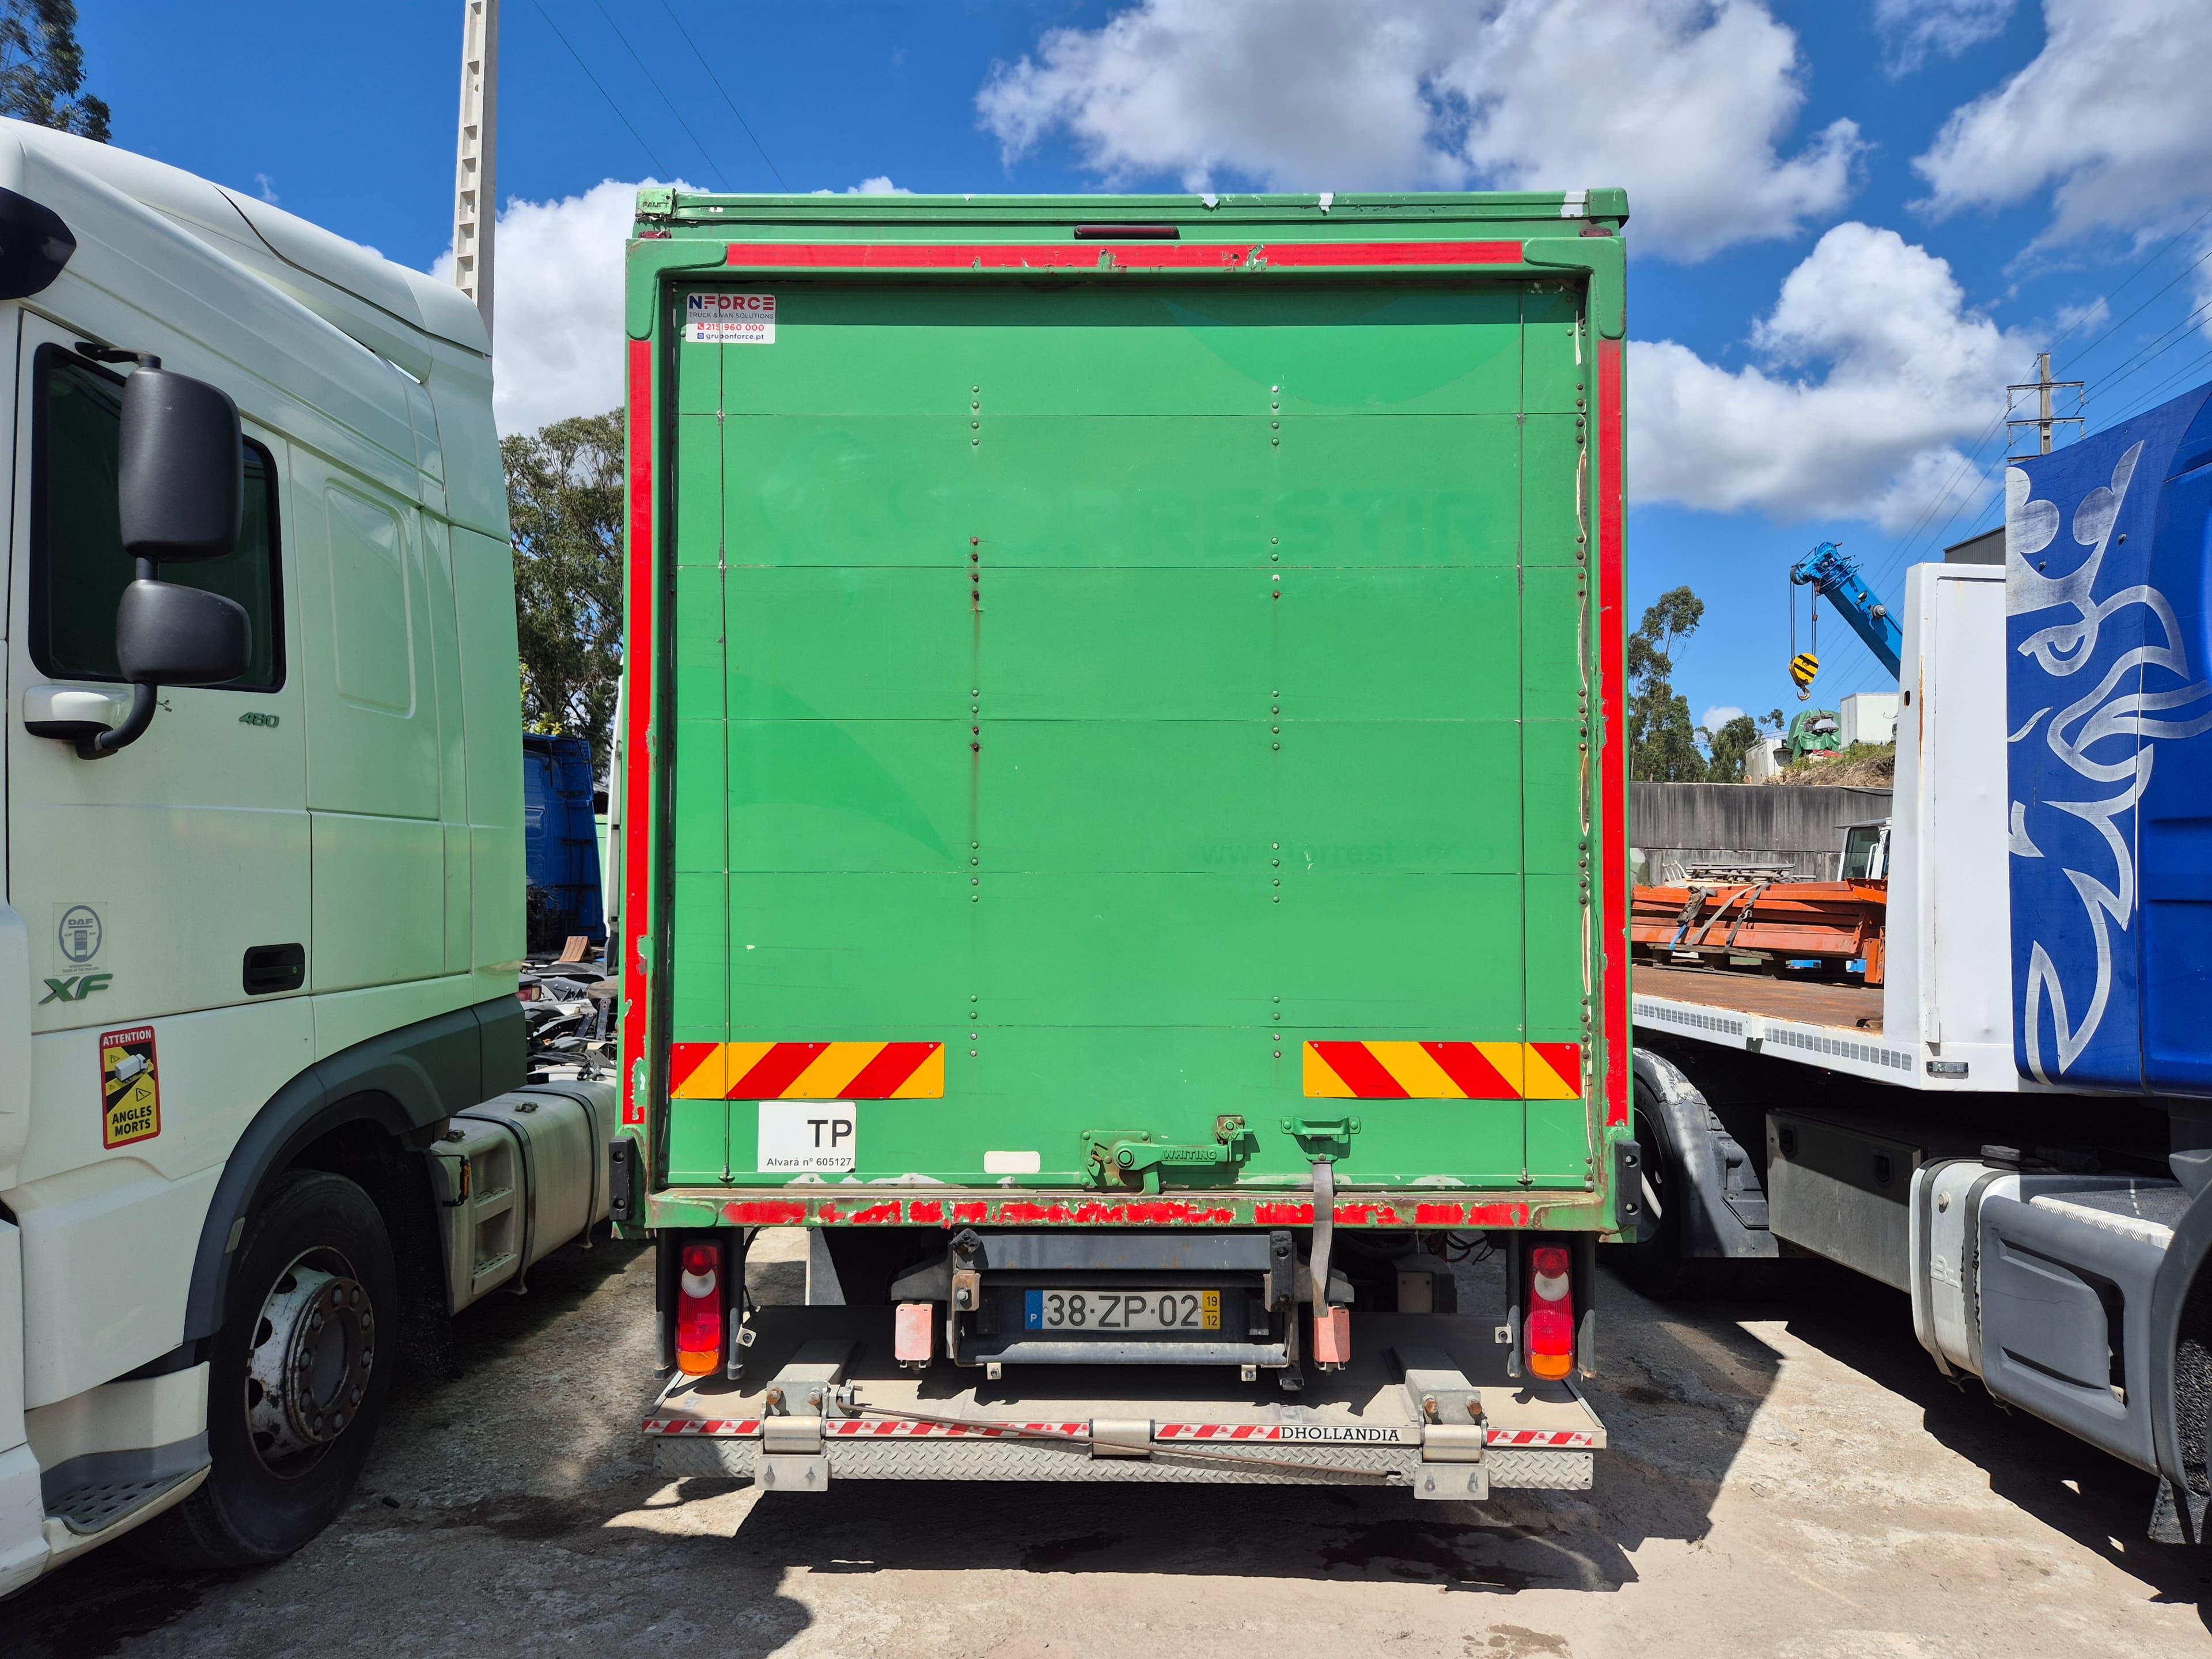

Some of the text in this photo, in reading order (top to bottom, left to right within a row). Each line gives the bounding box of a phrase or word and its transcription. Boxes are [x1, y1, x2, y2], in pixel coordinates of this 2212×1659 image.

[689, 295, 774, 310] NFORCE
[239, 712, 280, 728] 480
[39, 974, 113, 1005] XF
[103, 1029, 151, 1047] ATTENTION
[112, 1105, 152, 1124] ANGLES
[115, 1118, 151, 1137] MORTS
[807, 1120, 853, 1147] TP
[767, 1158, 799, 1166] Alvará
[816, 1158, 851, 1166] 605127
[1162, 1149, 1217, 1160] WHITING
[1207, 1296, 1218, 1306] 19
[1031, 1313, 1037, 1323] P
[1207, 1315, 1217, 1325] 12
[1281, 1427, 1400, 1441] DHOLLANDIA
